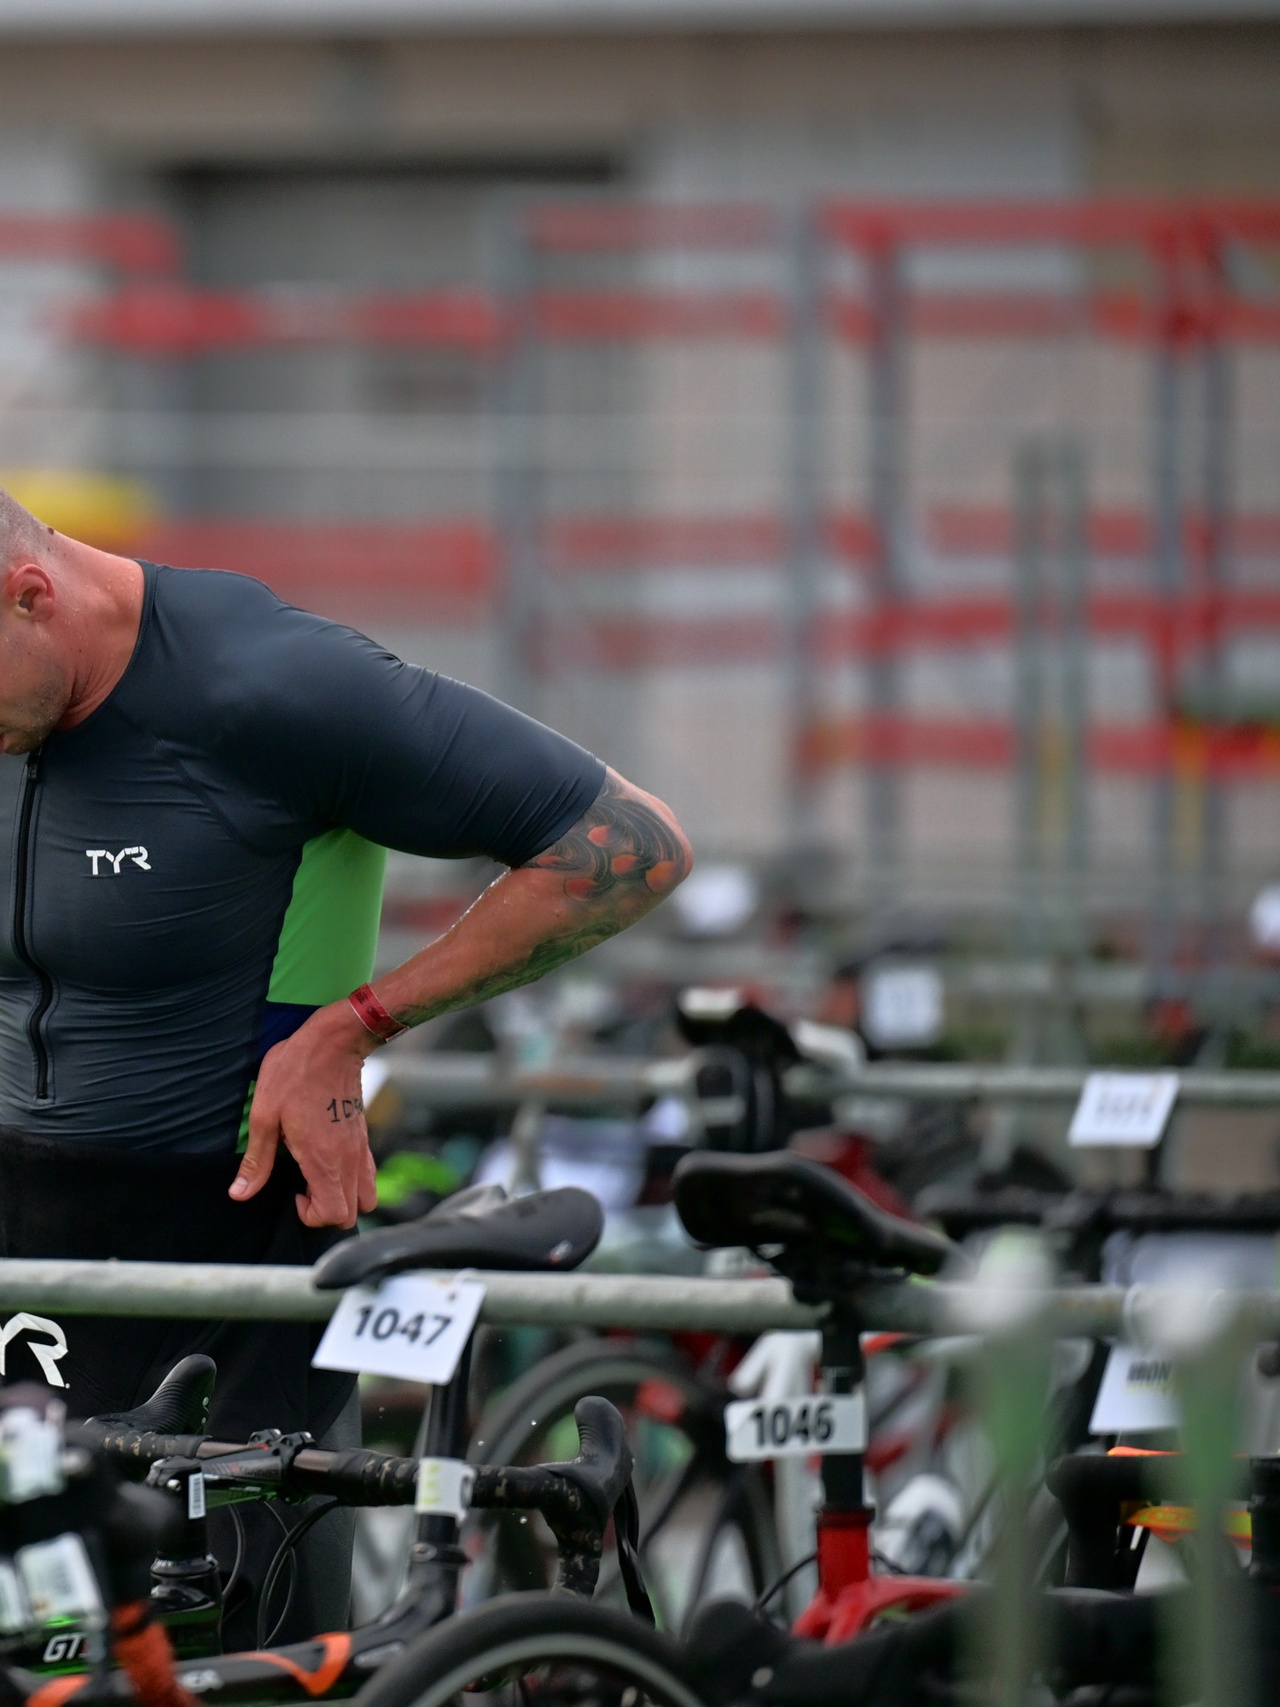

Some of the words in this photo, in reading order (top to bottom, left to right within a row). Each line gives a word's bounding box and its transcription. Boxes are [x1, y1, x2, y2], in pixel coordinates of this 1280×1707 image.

[85, 846, 152, 876] TYR
[354, 1304, 453, 1347] 1047
[751, 1402, 834, 1449] 1046
